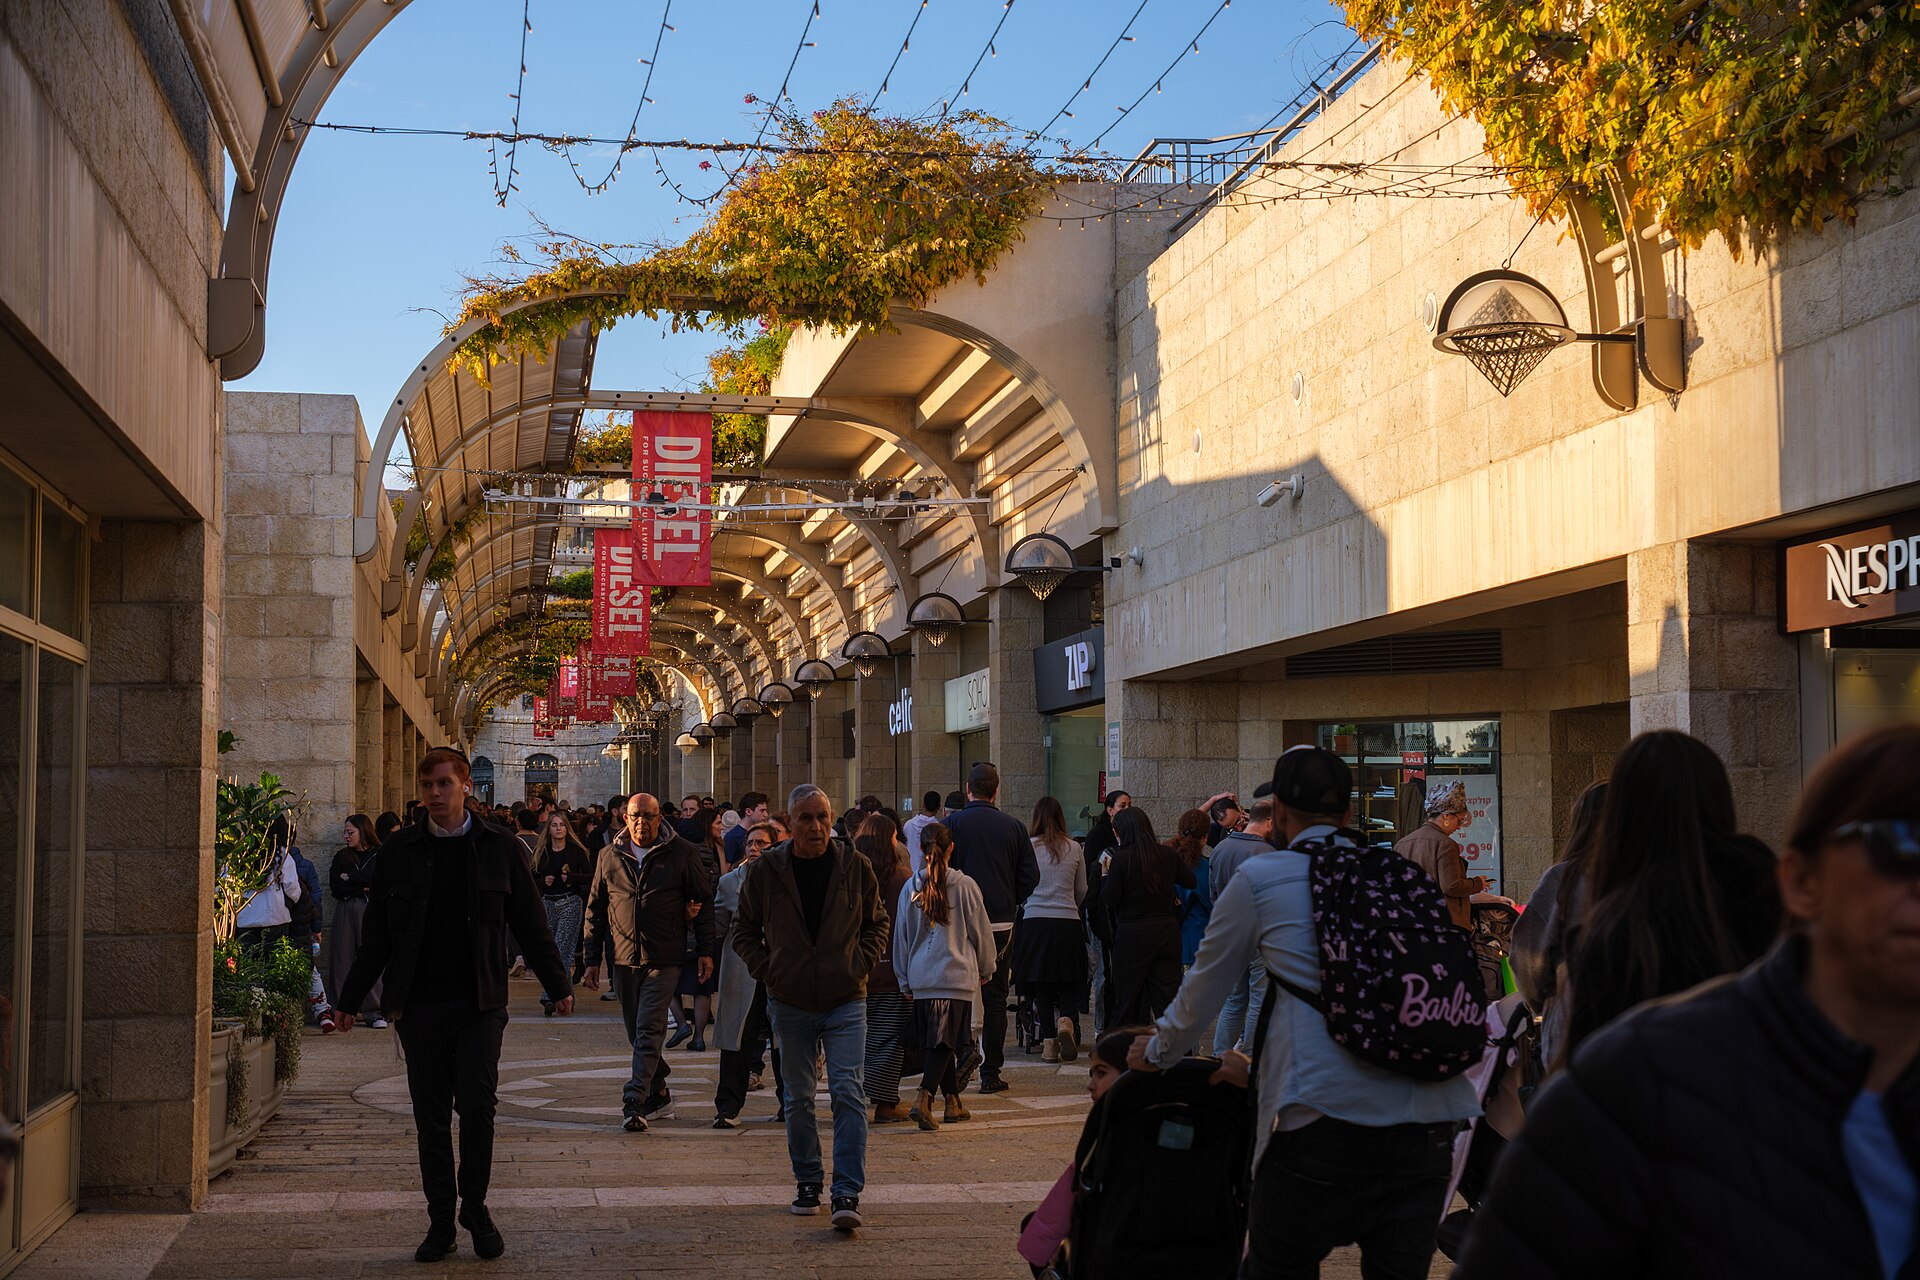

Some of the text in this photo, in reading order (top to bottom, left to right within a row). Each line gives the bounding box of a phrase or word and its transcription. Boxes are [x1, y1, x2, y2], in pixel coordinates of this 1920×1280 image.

[653, 435, 702, 561] DIESEL
[608, 546, 644, 637] DIESEL
[967, 675, 988, 711] SOHO
[1064, 641, 1095, 691] ZIP
[1398, 972, 1485, 1028] Barbie
